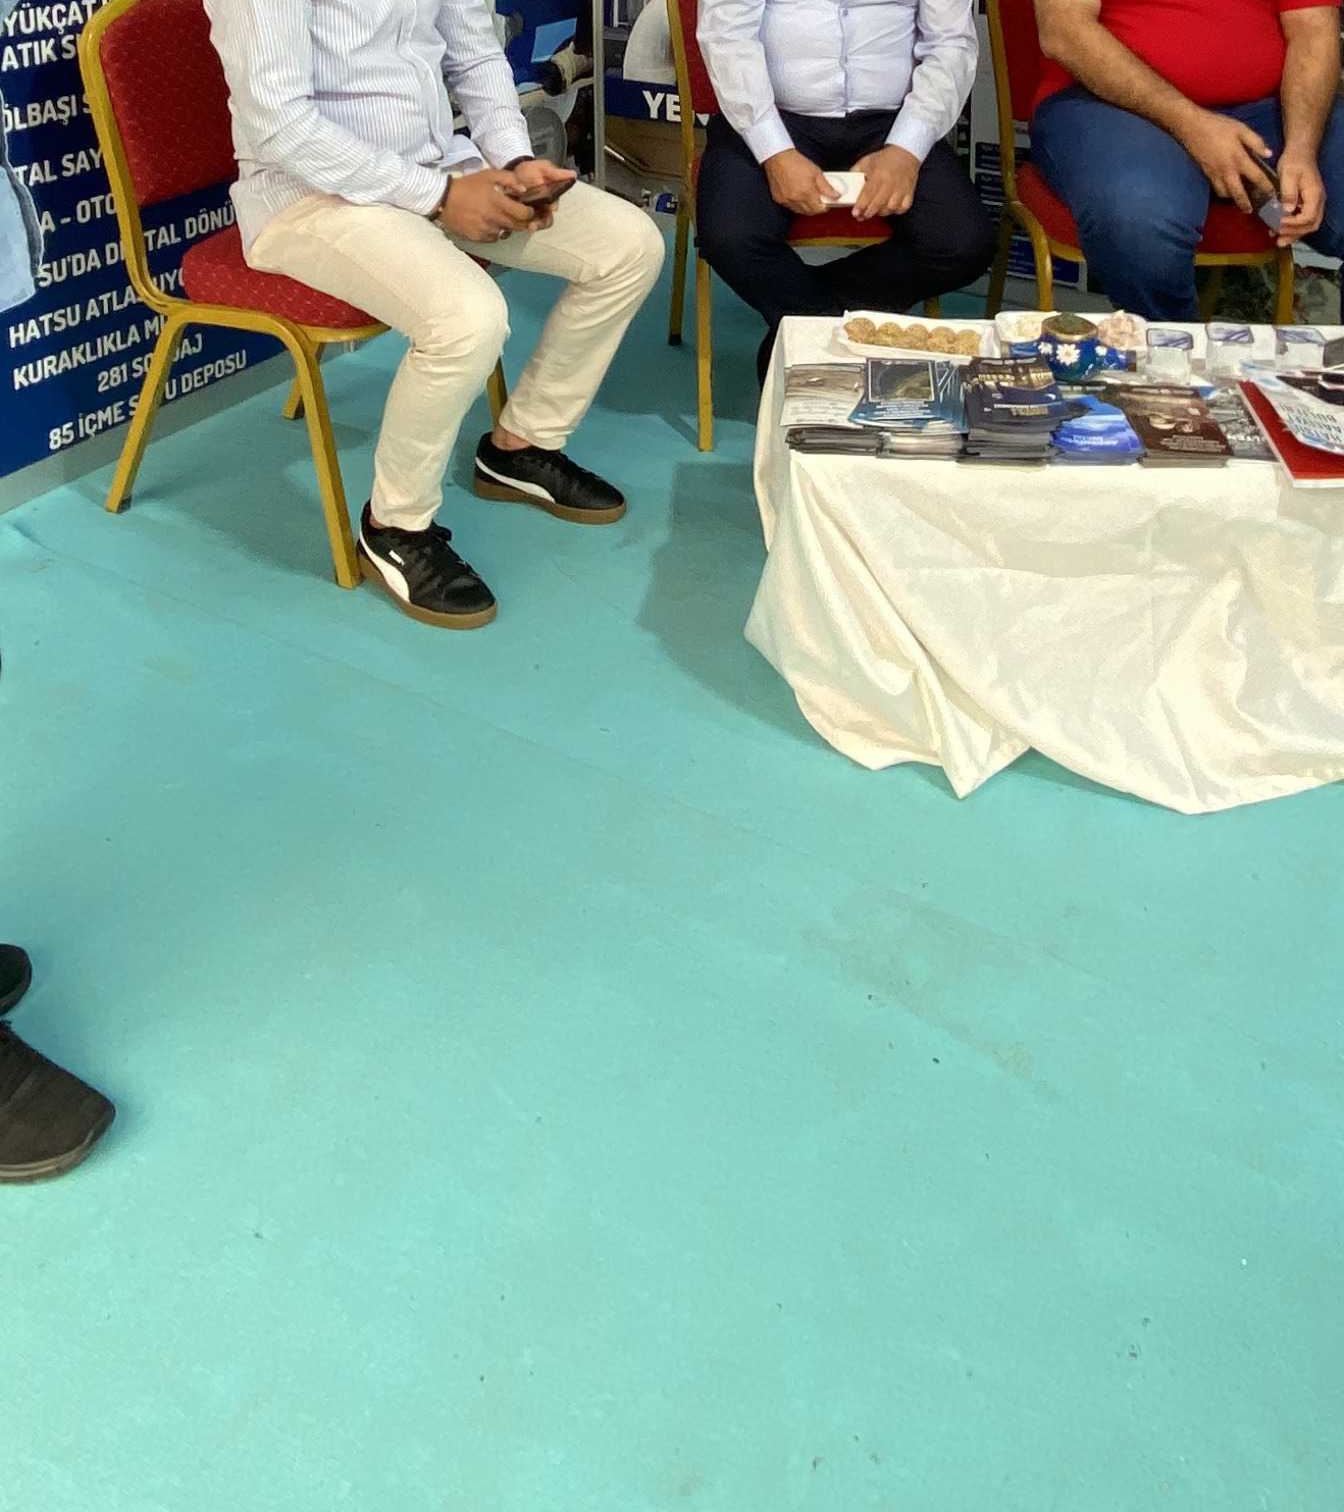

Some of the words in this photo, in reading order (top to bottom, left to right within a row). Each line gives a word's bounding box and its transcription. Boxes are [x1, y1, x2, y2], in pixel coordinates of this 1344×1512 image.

[1, 40, 58, 72] ATIK
[62, 35, 80, 60] S
[9, 303, 81, 349] HATSU
[86, 285, 144, 320] ATLA
[12, 328, 141, 391] KURAKLIKLA
[98, 364, 129, 393] 281
[132, 333, 204, 379] SOAJ
[49, 422, 75, 451] 85
[79, 400, 125, 439] İÇME
[181, 349, 248, 395] DEPOSU
